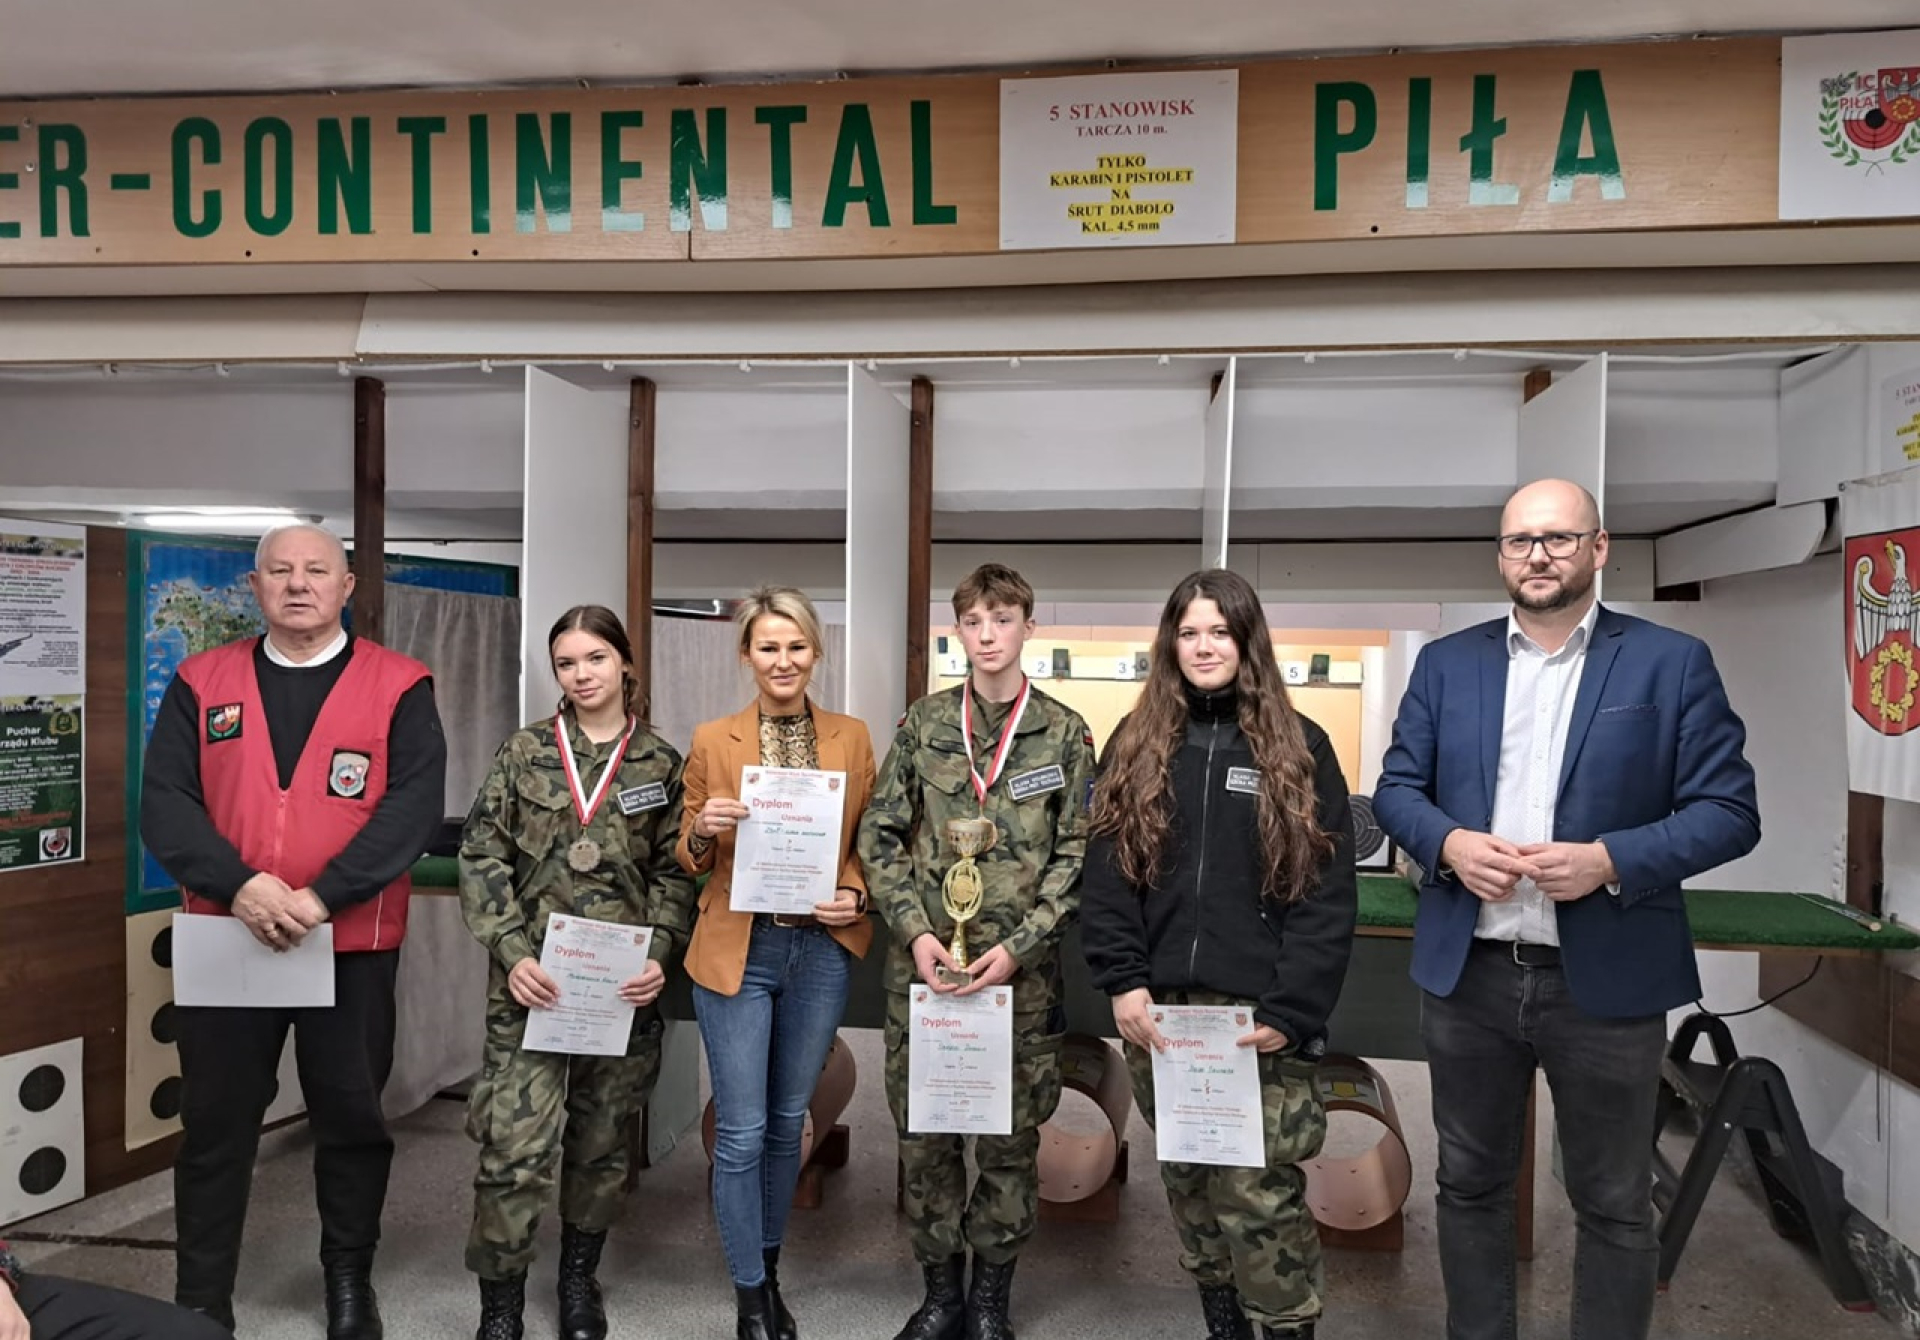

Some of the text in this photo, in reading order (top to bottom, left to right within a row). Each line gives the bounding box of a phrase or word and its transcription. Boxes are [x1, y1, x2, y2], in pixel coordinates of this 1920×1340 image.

[1049, 99, 1195, 121] 5 STANOWISK
[1076, 124, 1168, 137] TARCZA 10 m.
[1313, 69, 1626, 211] PIŁA
[1096, 156, 1146, 168] TYLKO
[1050, 174, 1114, 186] KARABIN
[1125, 170, 1194, 183] PISTOLET
[1111, 189, 1131, 199] NA
[1067, 203, 1174, 217] ŚRUT DIABOLO
[1082, 222, 1113, 232] KAL.
[1138, 222, 1160, 231] mm
[1037, 661, 1046, 673] 2
[1118, 661, 1127, 674] 3
[1289, 667, 1299, 679] 5
[6, 727, 42, 736] Puchar
[30, 737, 59, 746] Klubu
[752, 798, 793, 809] Dyplom
[555, 945, 595, 959] Dyplom
[921, 1017, 961, 1028] Dyplom
[1163, 1037, 1204, 1049] Dyplom
